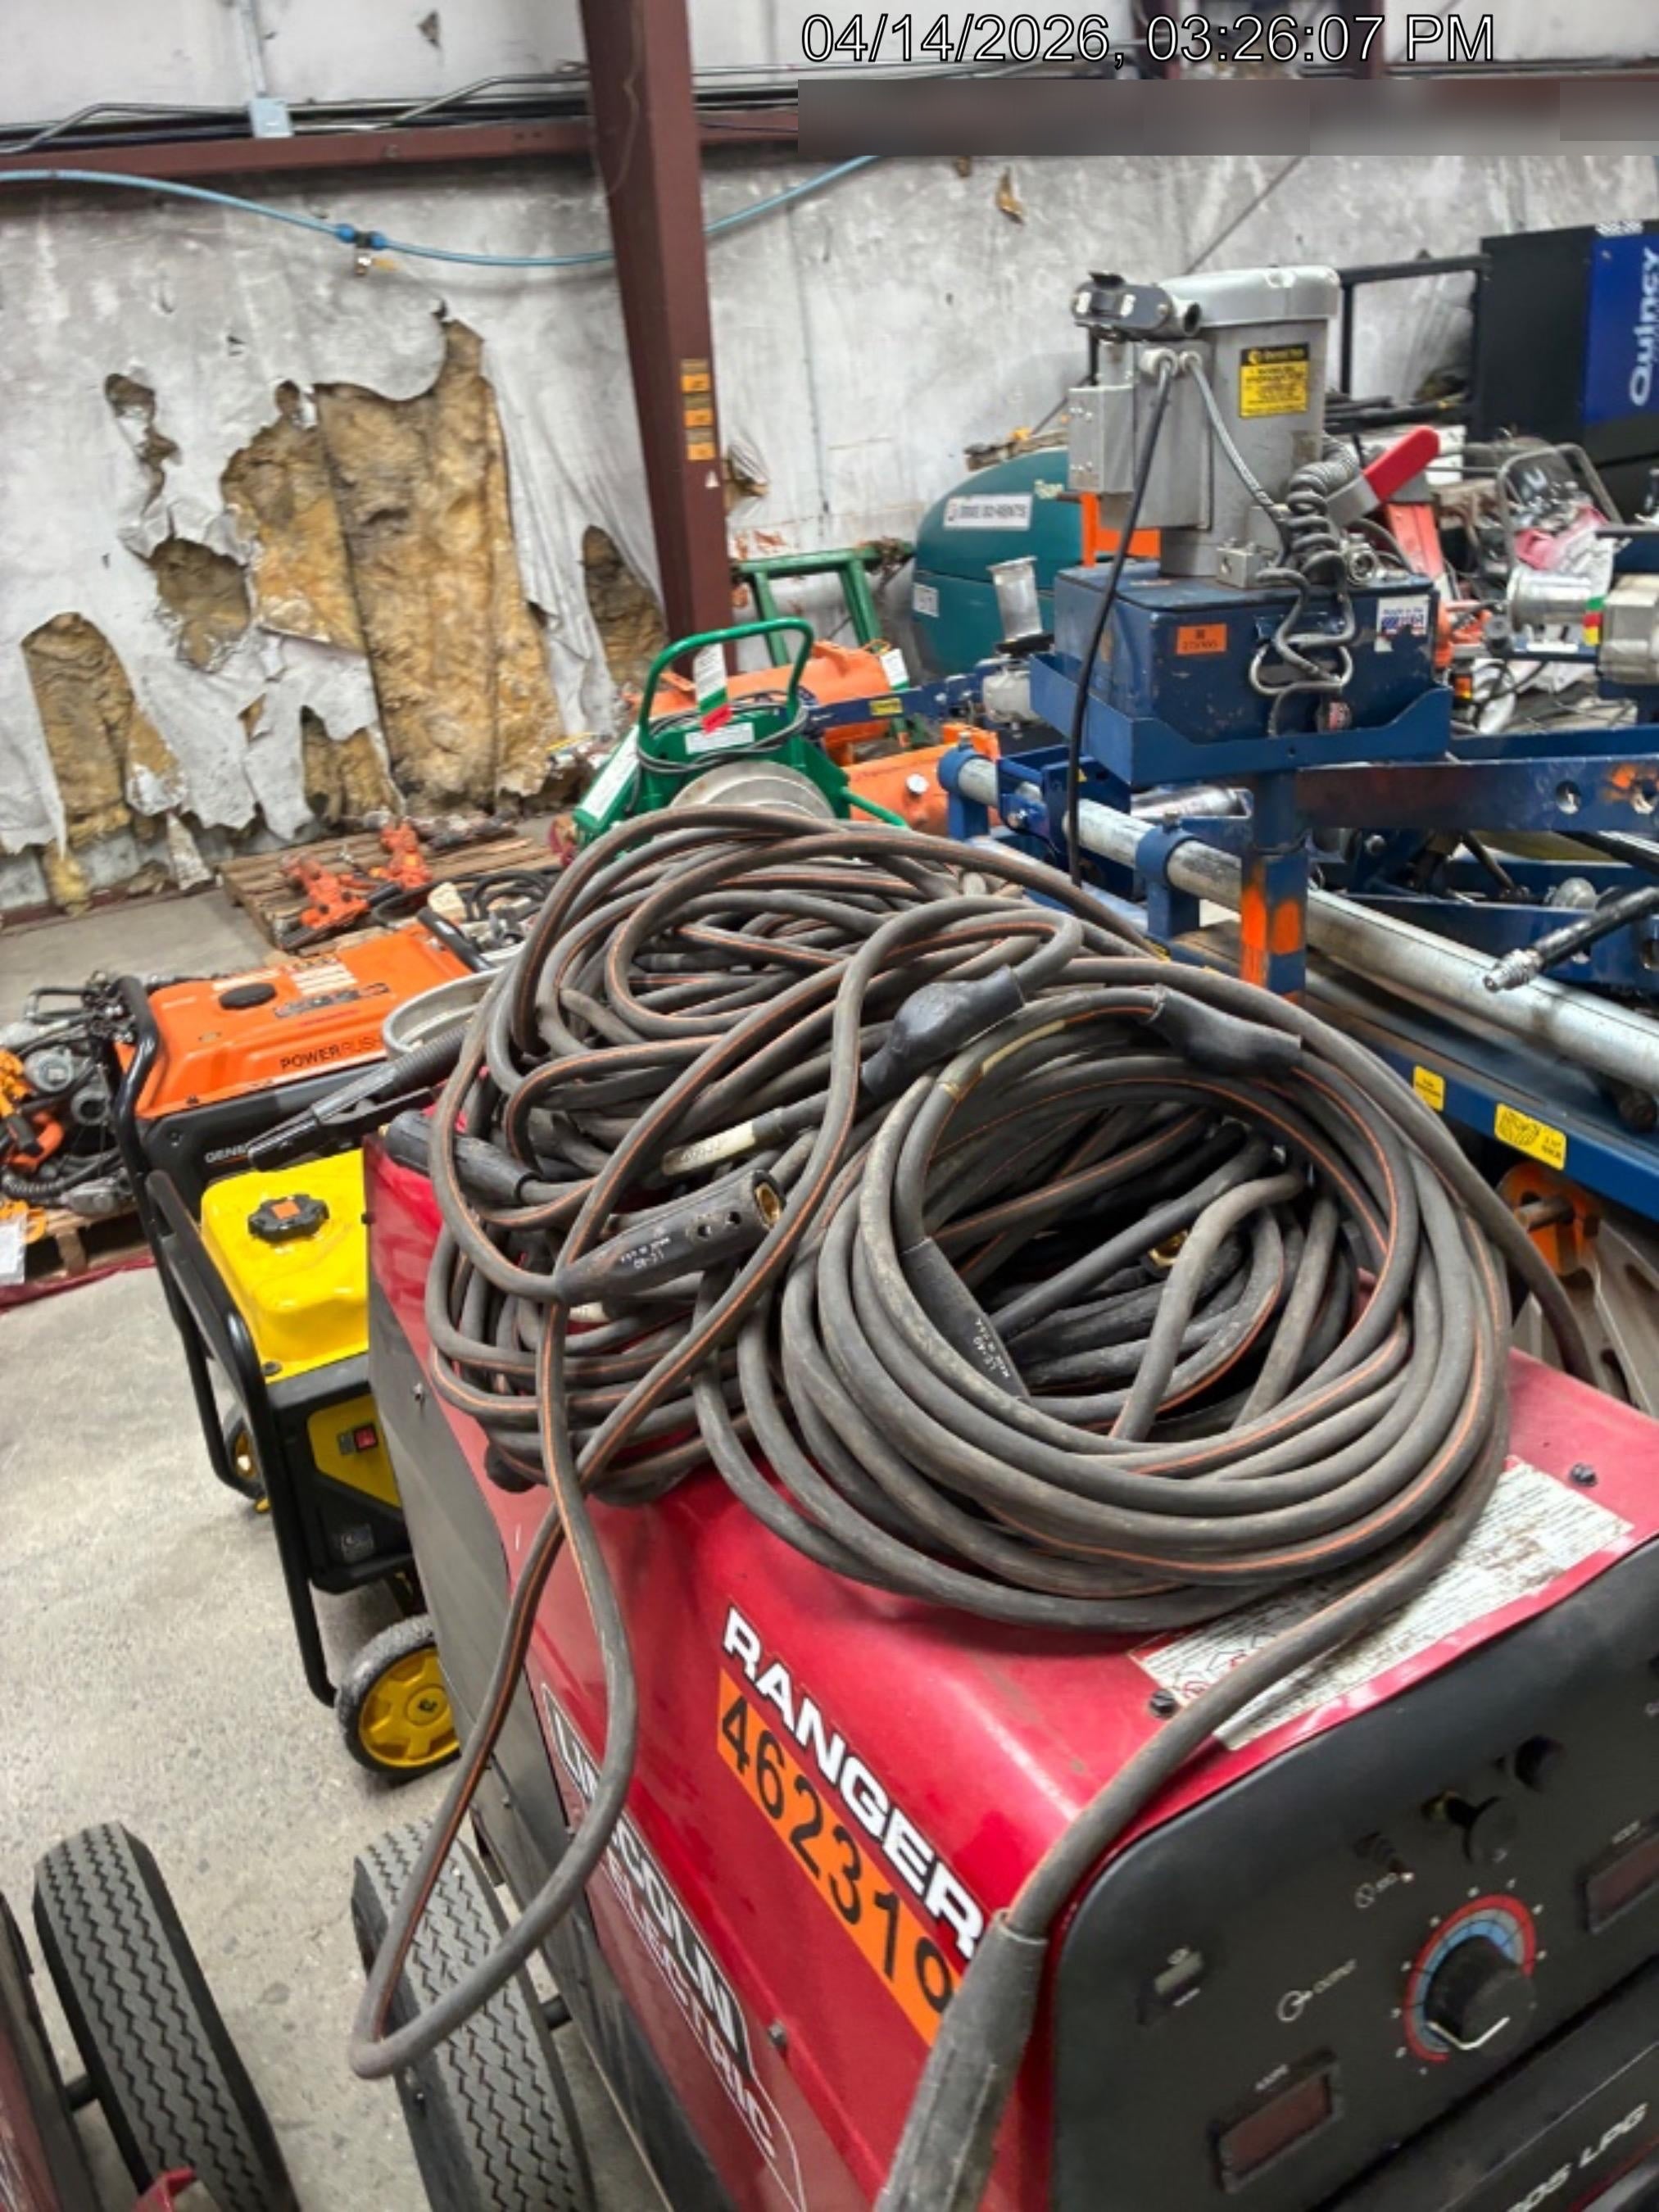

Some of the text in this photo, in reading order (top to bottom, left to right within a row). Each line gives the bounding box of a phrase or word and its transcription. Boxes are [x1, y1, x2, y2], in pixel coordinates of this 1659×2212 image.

[723, 1607, 984, 1960] RANGER
[605, 1846, 777, 2158] ELECTRIC
[1578, 2101, 1649, 2169] LPG
